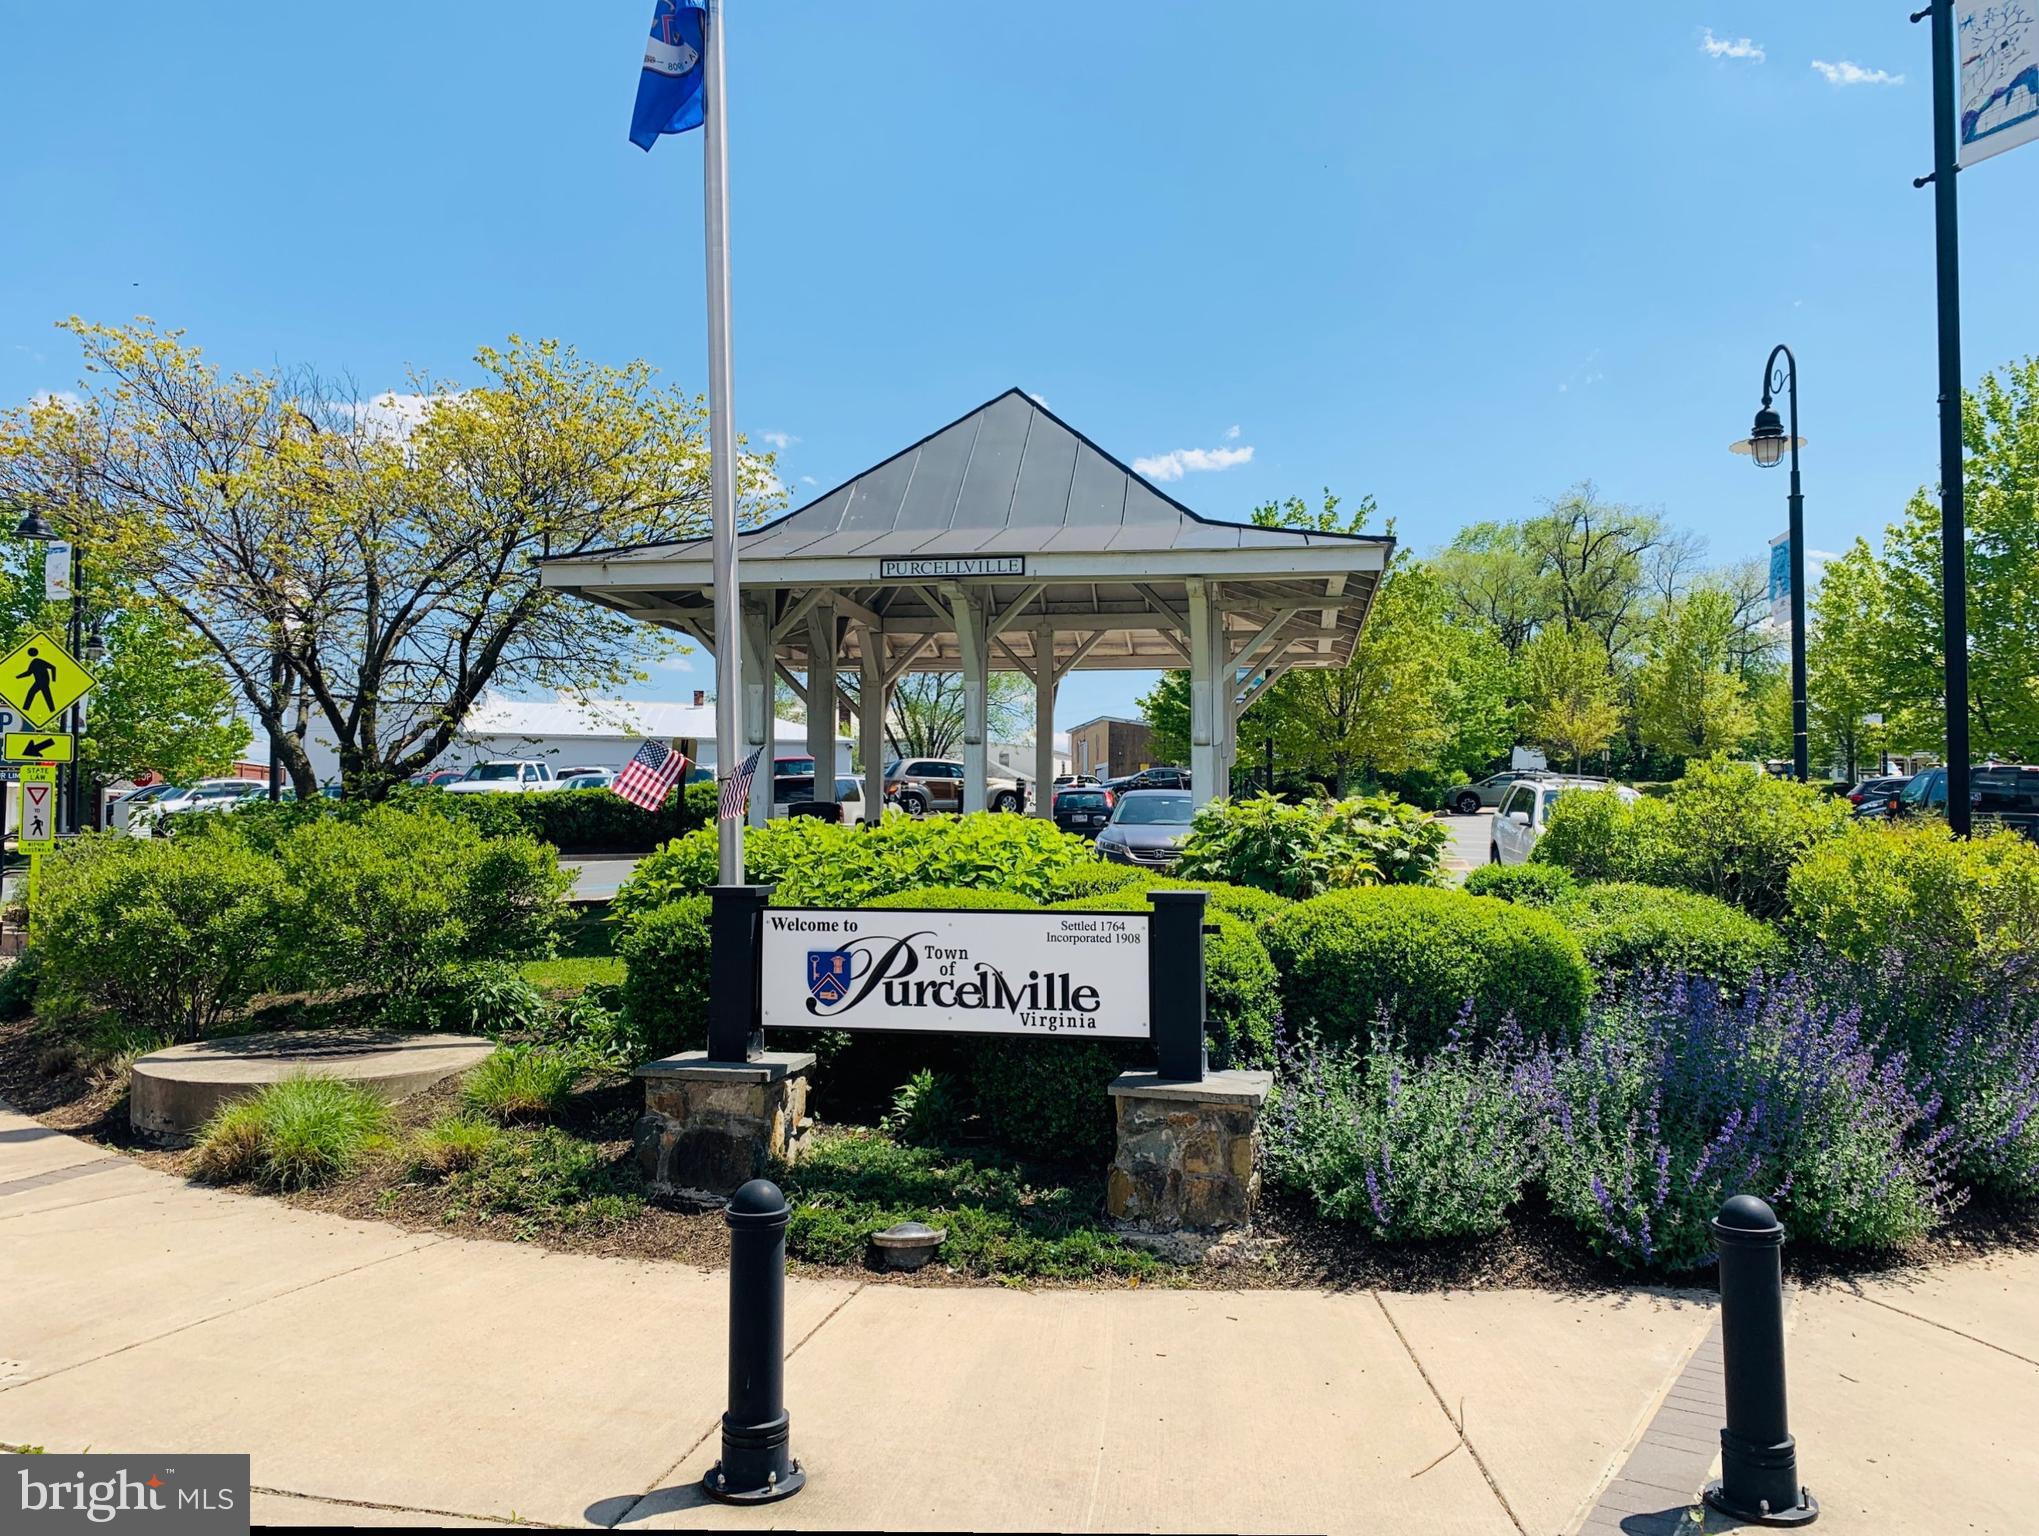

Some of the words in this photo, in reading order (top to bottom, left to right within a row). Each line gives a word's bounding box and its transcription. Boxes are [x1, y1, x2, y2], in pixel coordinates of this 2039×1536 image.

[886, 559, 1019, 575] PURCELLVILLE
[771, 917, 839, 932] Welcome
[843, 918, 858, 932] to
[1061, 920, 1097, 932] Settled
[1100, 921, 1126, 932] 1764
[1046, 932, 1111, 945] Incorporated
[1115, 933, 1141, 944] 1908
[925, 945, 969, 960] Town
[939, 961, 957, 976] of
[1020, 1012, 1097, 1031] Virginia
